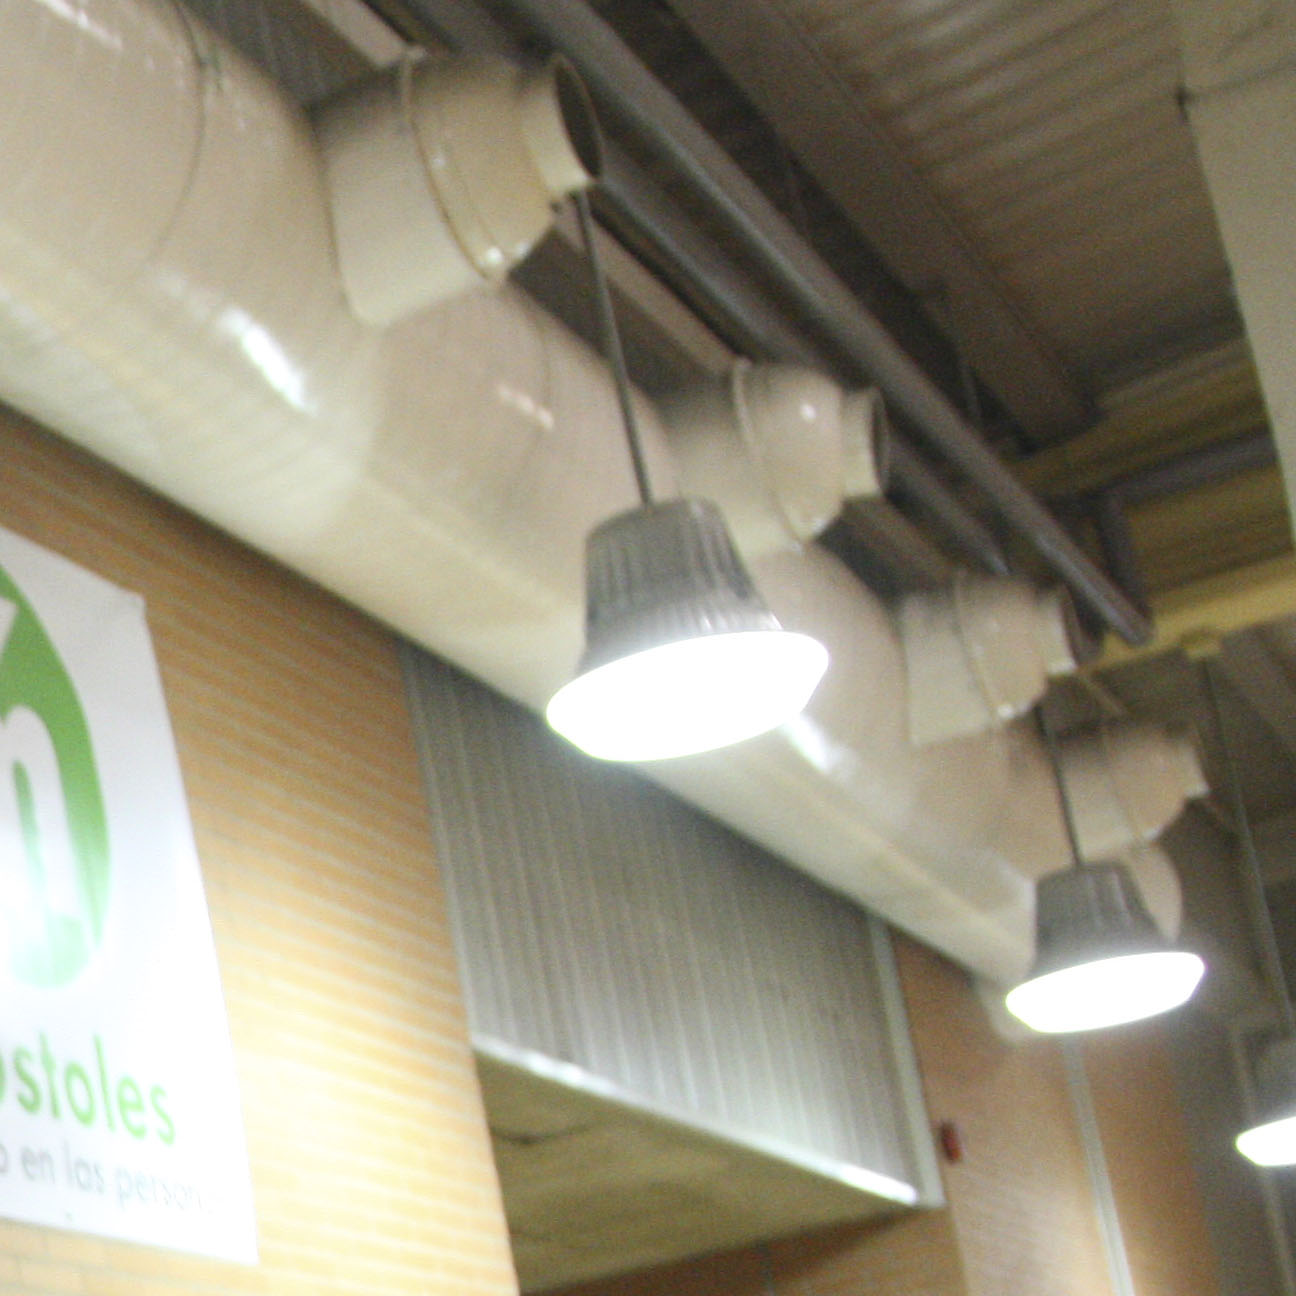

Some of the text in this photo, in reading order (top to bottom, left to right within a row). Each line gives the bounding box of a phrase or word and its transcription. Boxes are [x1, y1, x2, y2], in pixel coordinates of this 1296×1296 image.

[21, 1145, 54, 1181] en
[65, 1142, 105, 1194] las
[114, 1163, 208, 1214] person
